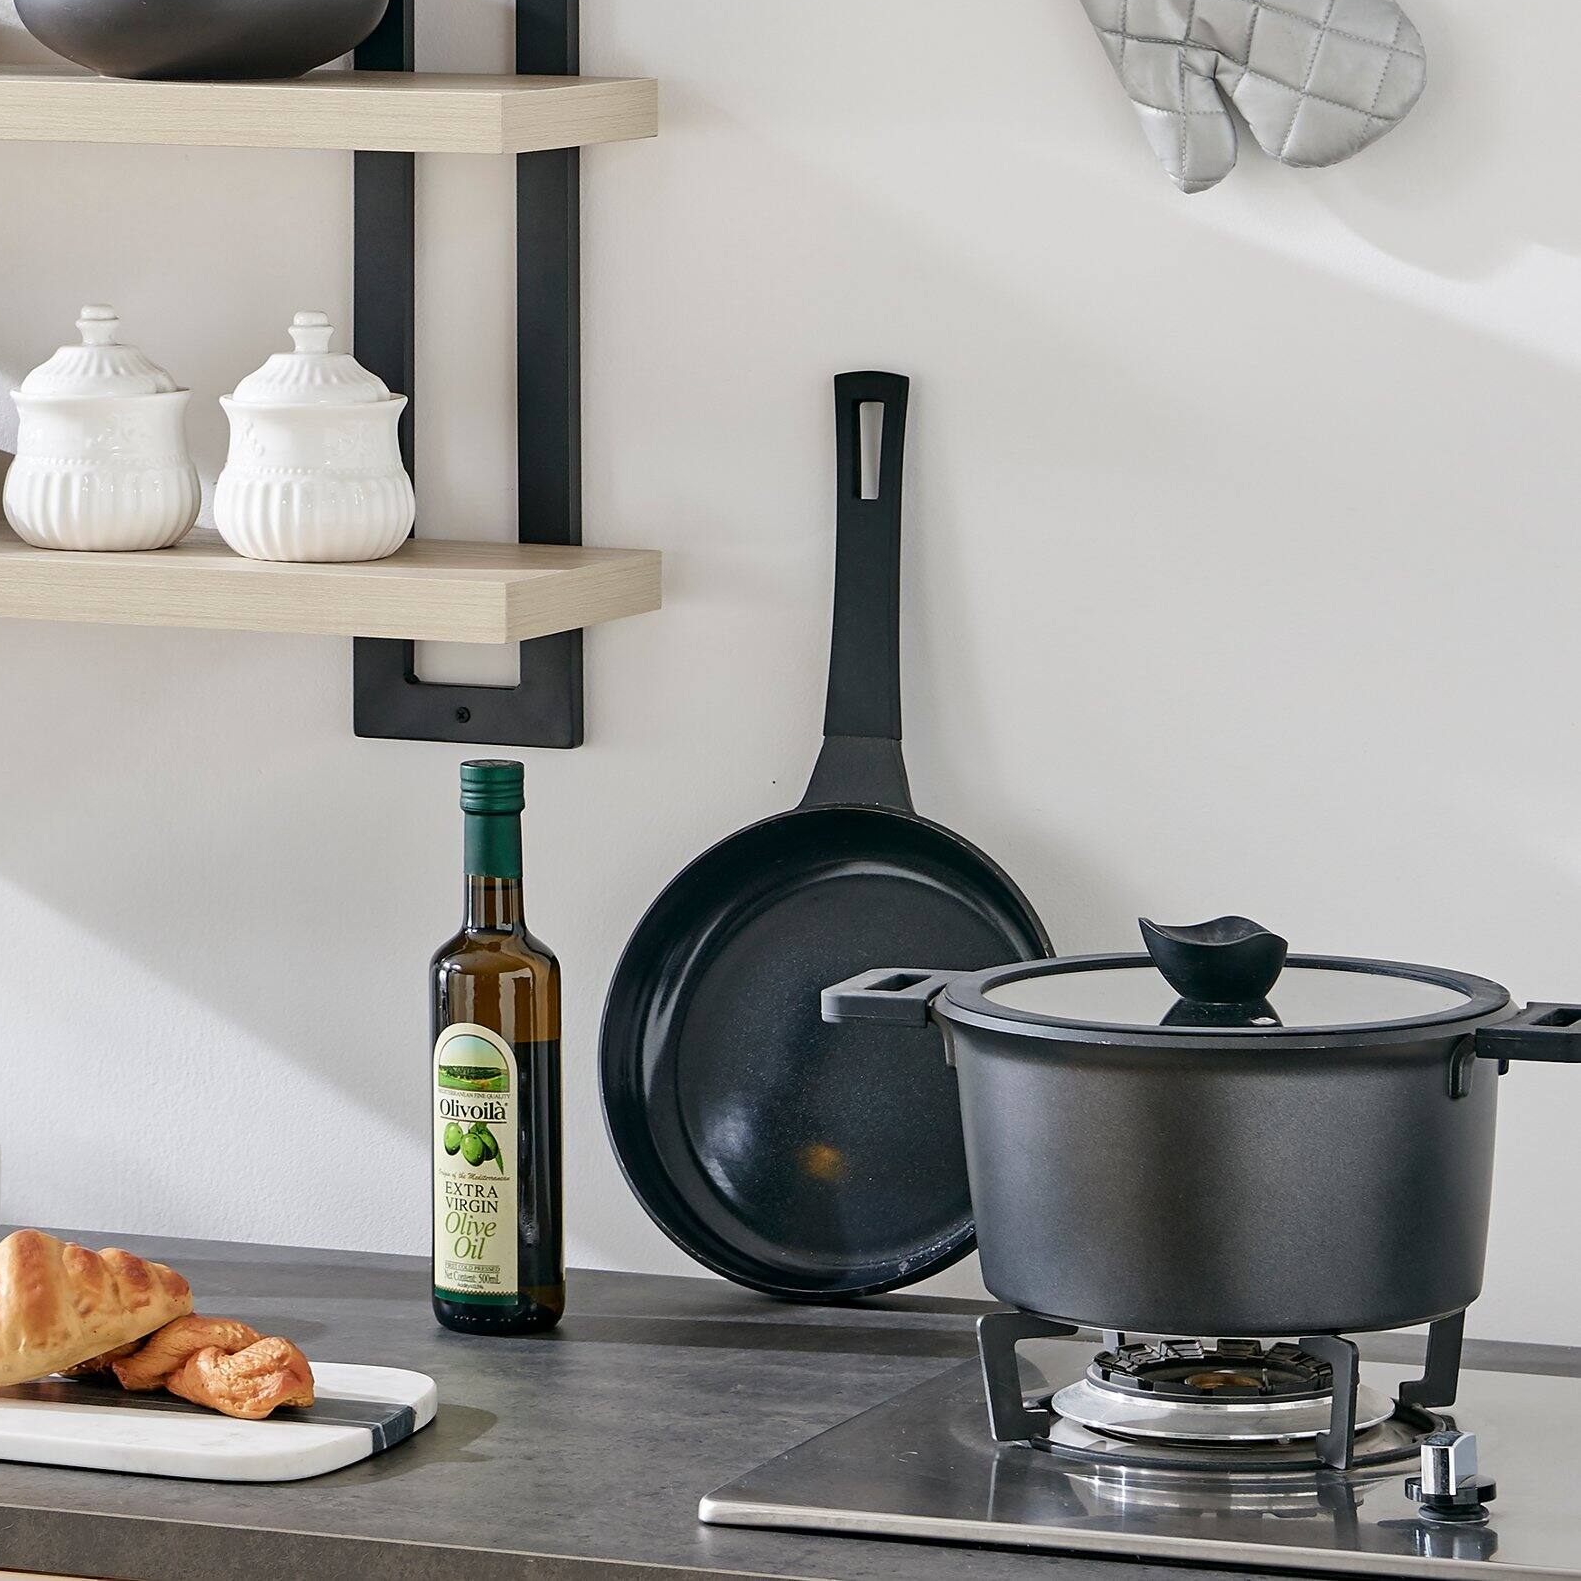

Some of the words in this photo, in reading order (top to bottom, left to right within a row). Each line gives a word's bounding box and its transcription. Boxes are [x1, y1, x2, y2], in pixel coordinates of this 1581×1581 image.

[440, 1099, 506, 1120] Olivoilà
[445, 1181, 498, 1198] EXTRA
[446, 1196, 498, 1213] VIRGIN
[445, 1211, 497, 1237] Olive
[454, 1236, 485, 1259] Oil
